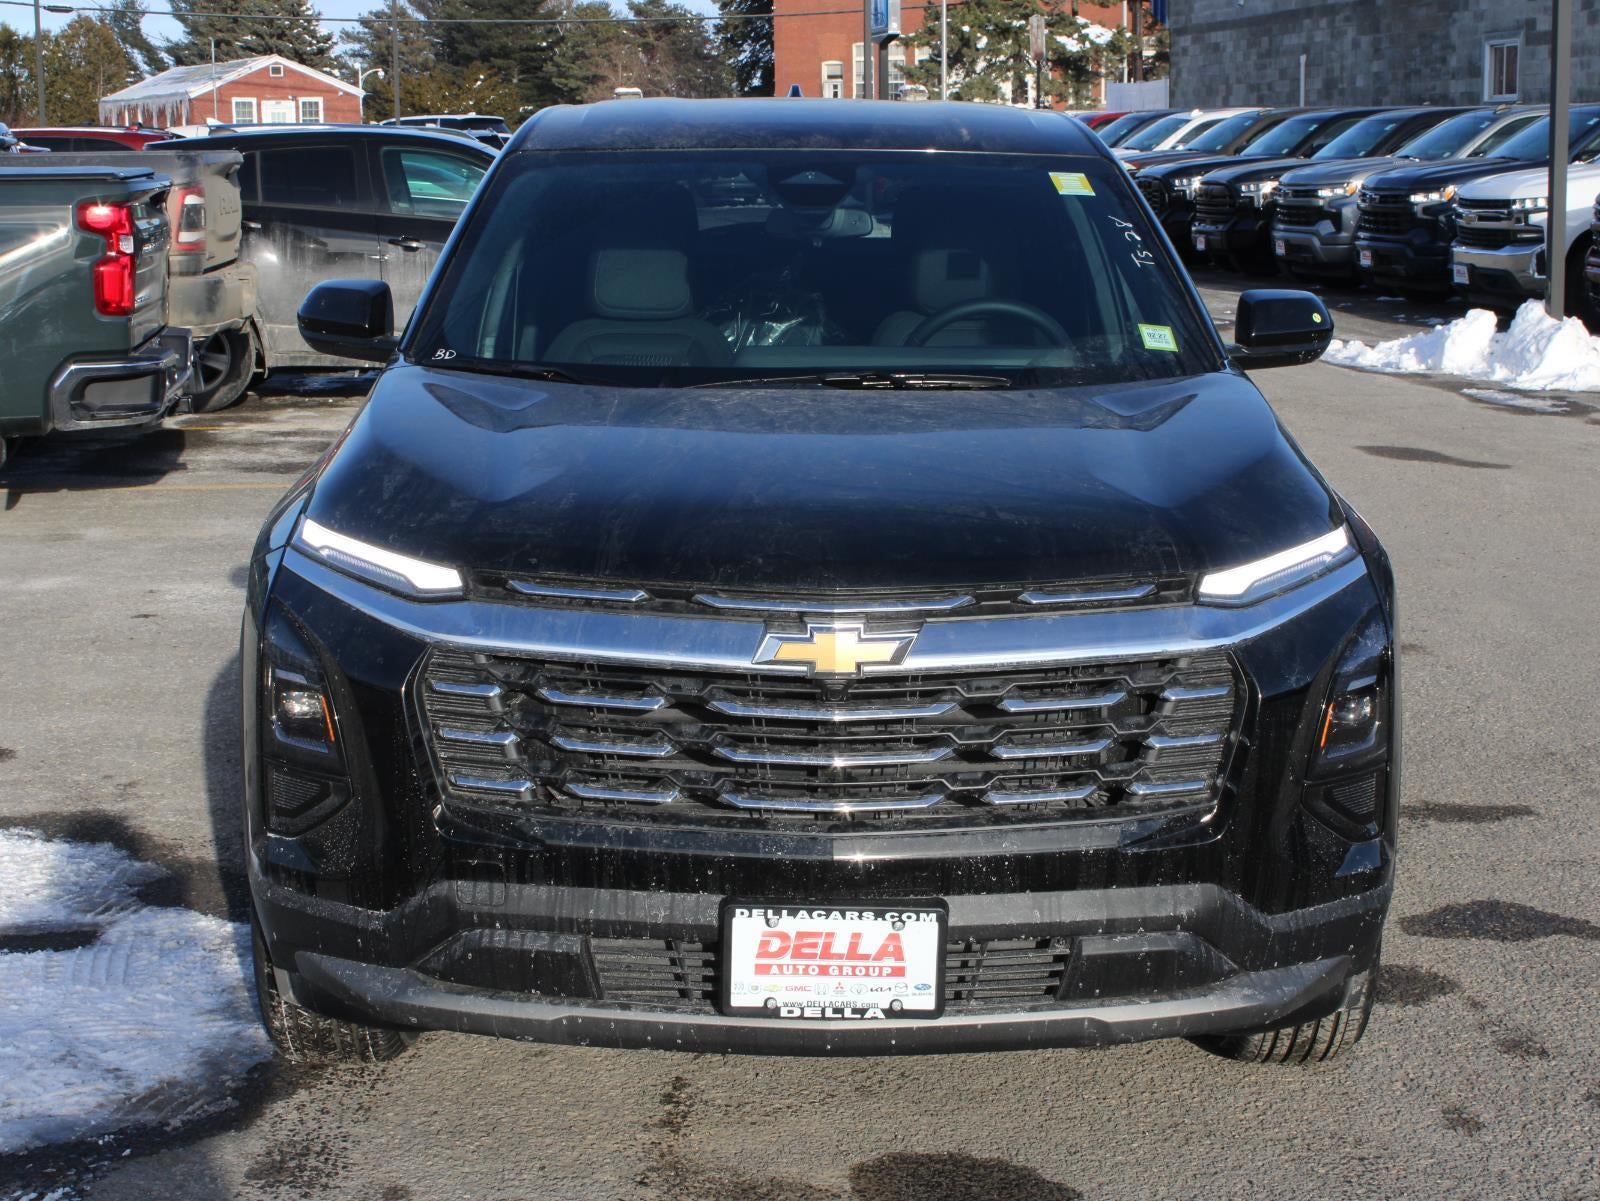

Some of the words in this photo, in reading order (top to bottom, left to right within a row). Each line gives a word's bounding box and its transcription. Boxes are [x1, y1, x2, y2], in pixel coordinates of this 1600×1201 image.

[431, 348, 457, 360] BD
[734, 908, 937, 923] DELLACARS.COM
[755, 930, 905, 962] DELLA
[769, 965, 819, 976] AUTO
[829, 966, 892, 977] GROUP
[780, 1007, 886, 1019] DELLA
